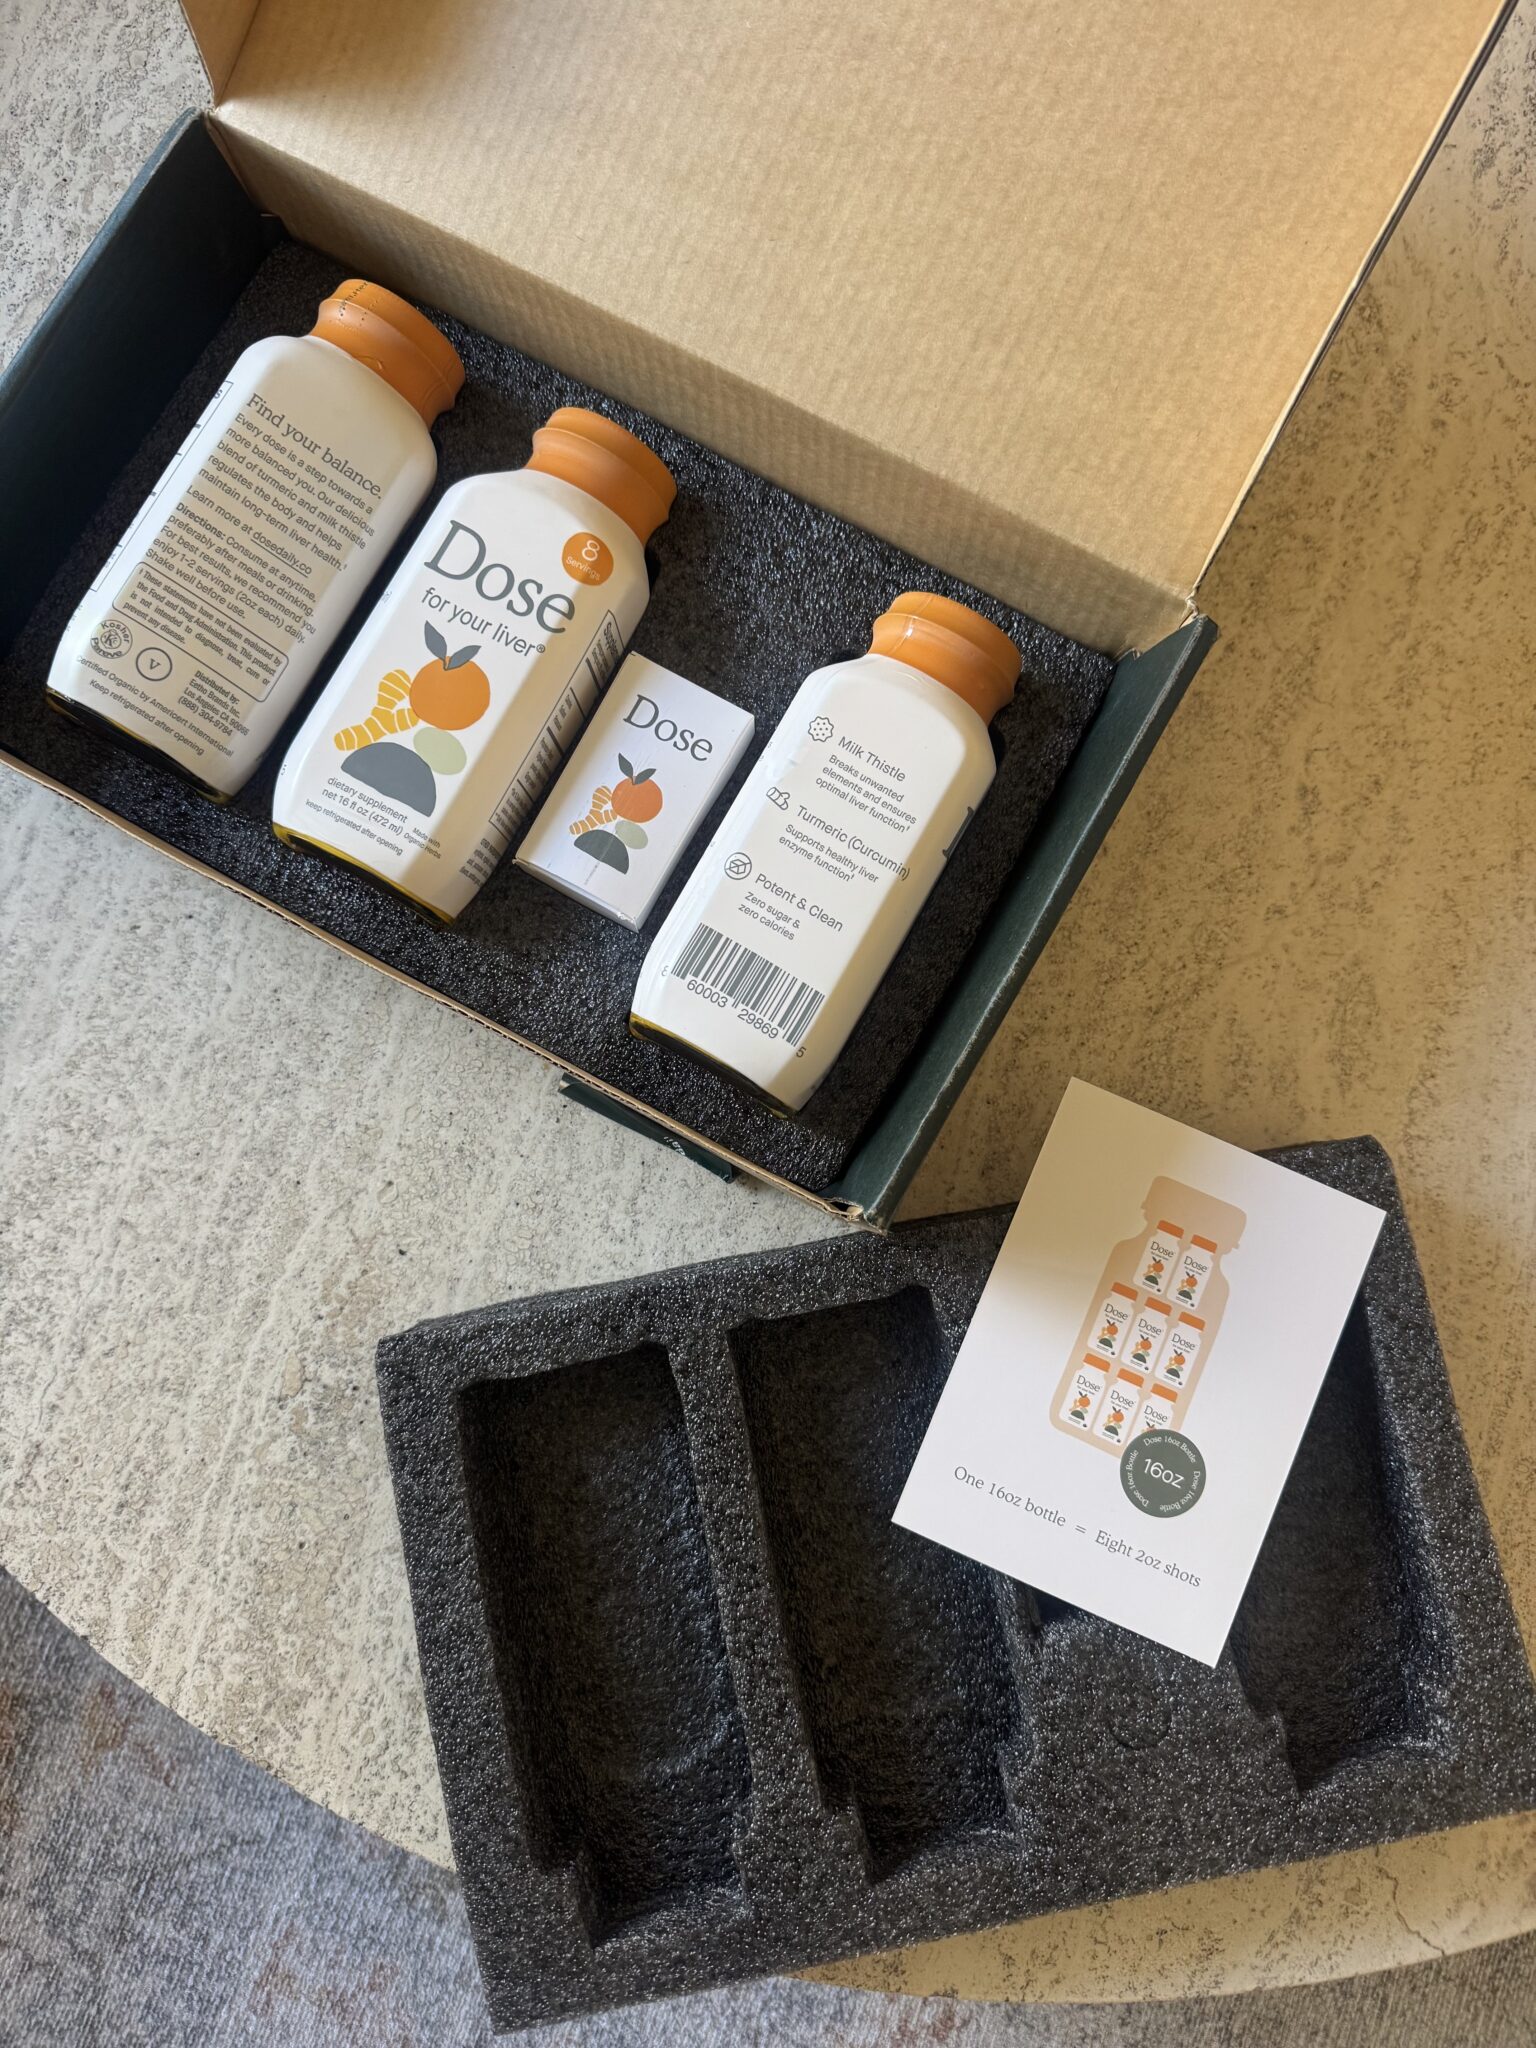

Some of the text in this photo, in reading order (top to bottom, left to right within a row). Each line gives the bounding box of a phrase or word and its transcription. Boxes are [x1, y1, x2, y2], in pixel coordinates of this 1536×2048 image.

[234, 412, 373, 515] Every dose is a step towards a
[246, 392, 381, 500] Find your balance.
[198, 468, 241, 501] maintain
[240, 495, 289, 534] long-term
[288, 528, 312, 548] liver
[207, 454, 343, 551] regulates the body and helps
[216, 439, 366, 550] blend of turmeric and milk thistle
[225, 427, 375, 537] more balanced you. Our delicious
[175, 501, 316, 603] Directions: Consume at anytime,
[185, 484, 312, 575] Learn more at dosedaily.co
[581, 539, 600, 562] 8
[145, 548, 246, 619] Shake well before use.
[152, 538, 306, 644] enjoy 1-2 servings (2oz each) daily.
[160, 524, 178, 540] For
[175, 534, 200, 555] best
[233, 573, 248, 587] we
[247, 584, 303, 624] recommend
[300, 619, 316, 635] you
[166, 514, 314, 617] preferably after meals or drinking.
[423, 519, 575, 634] Dose
[100, 620, 130, 644] Kosher
[143, 569, 283, 667] These statements have not been evaluated by
[421, 586, 451, 612] for
[447, 604, 493, 634] your
[89, 678, 205, 756] Keep refrigerated after opening
[107, 672, 140, 695] Organic
[138, 690, 151, 703] by
[187, 722, 234, 757] International
[177, 695, 199, 714] (888)
[183, 686, 230, 723] Los Angeles CA
[194, 669, 240, 705] Distributed by:
[622, 693, 713, 761] Dose
[828, 754, 905, 803] Breaks unwanted
[837, 735, 906, 782] Milk Thistle
[321, 788, 338, 801] net
[338, 795, 350, 806] 16
[356, 806, 369, 817] oz
[368, 810, 390, 827] (472
[387, 823, 404, 836] ml)
[327, 777, 408, 824] dietary supplement
[815, 777, 850, 800] optimal
[848, 794, 869, 812] liver
[822, 766, 917, 825] elements and ensures
[305, 798, 403, 856] keep refrigerated after opening
[778, 836, 814, 860] enzyme
[785, 823, 879, 883] Supports healthy liver
[797, 804, 910, 881] Turmeric (Curcumin)
[737, 903, 795, 941] zero calories
[744, 891, 800, 929] Zero sugar &
[754, 872, 843, 932] Potent & Clean
[686, 979, 728, 1008] 60003
[736, 1008, 779, 1039] 29869
[795, 1046, 807, 1058] 5
[1144, 1458, 1184, 1489] 16oz
[954, 1466, 984, 1489] One
[988, 1482, 1022, 1507] 16oz
[1024, 1497, 1066, 1527] bottle
[1094, 1529, 1133, 1557] Eight
[1134, 1549, 1162, 1570] 2oz
[1163, 1562, 1201, 1587] shots
